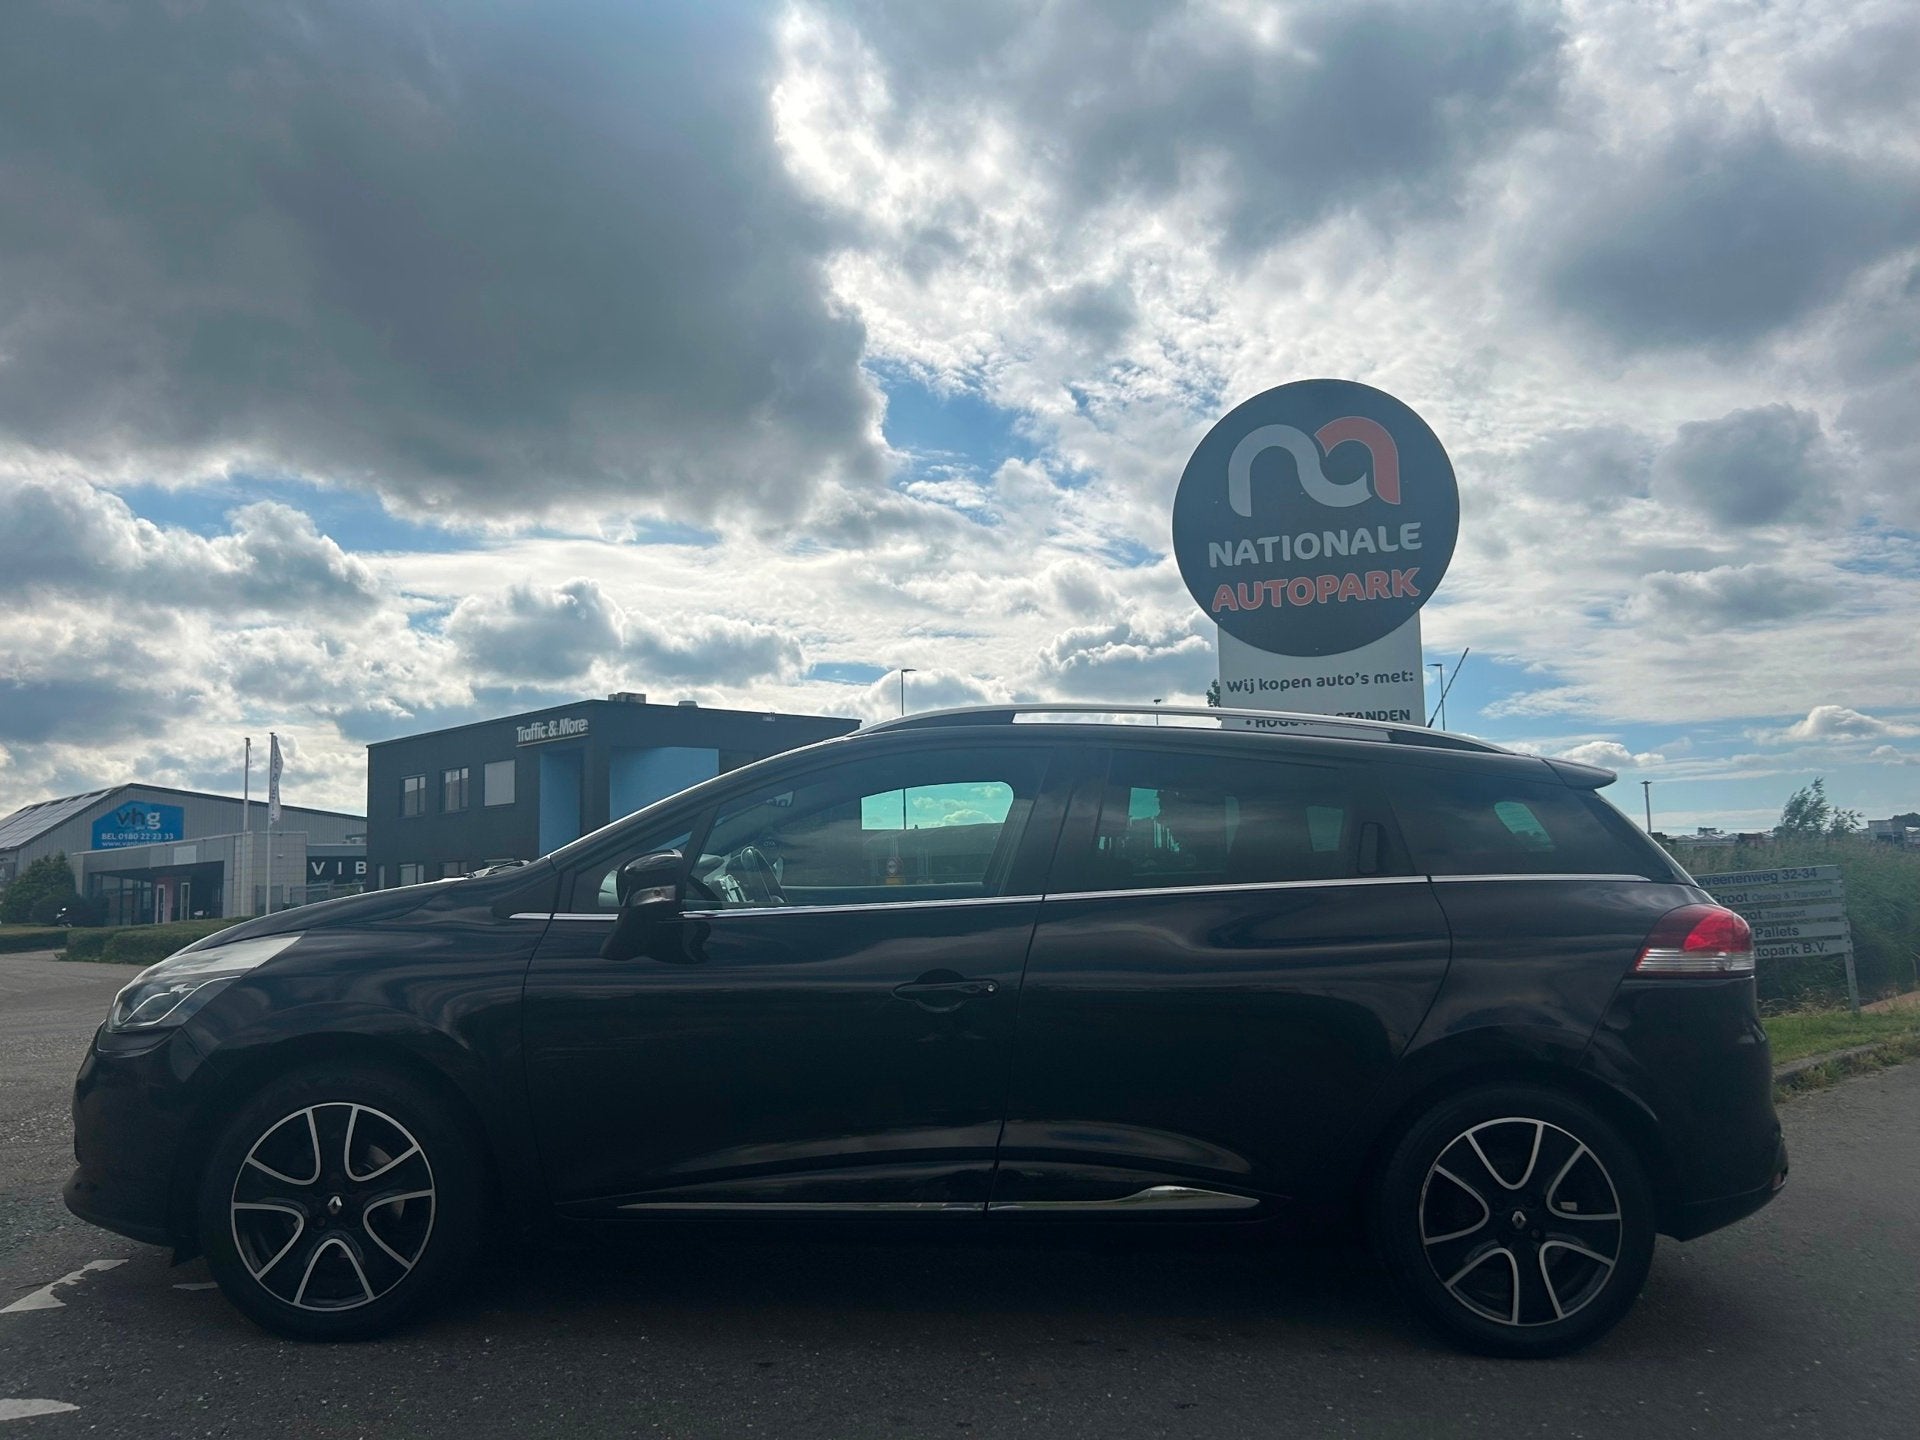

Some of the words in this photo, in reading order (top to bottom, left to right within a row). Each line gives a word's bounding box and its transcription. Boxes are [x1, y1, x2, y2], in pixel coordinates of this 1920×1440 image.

[1208, 522, 1422, 568] NATIONALE
[1211, 567, 1421, 613] AUTOPARK
[1227, 678, 1255, 694] Wij
[1259, 676, 1312, 692] kopen
[1316, 672, 1369, 687] auto's
[1374, 670, 1414, 684] met:
[516, 722, 548, 742] Traffic
[548, 720, 558, 737] &
[559, 717, 589, 735] More
[117, 808, 160, 829] vhg
[1782, 867, 1818, 880] 32-34
[1755, 926, 1800, 938] Pallets
[1802, 942, 1828, 954] B.V.
